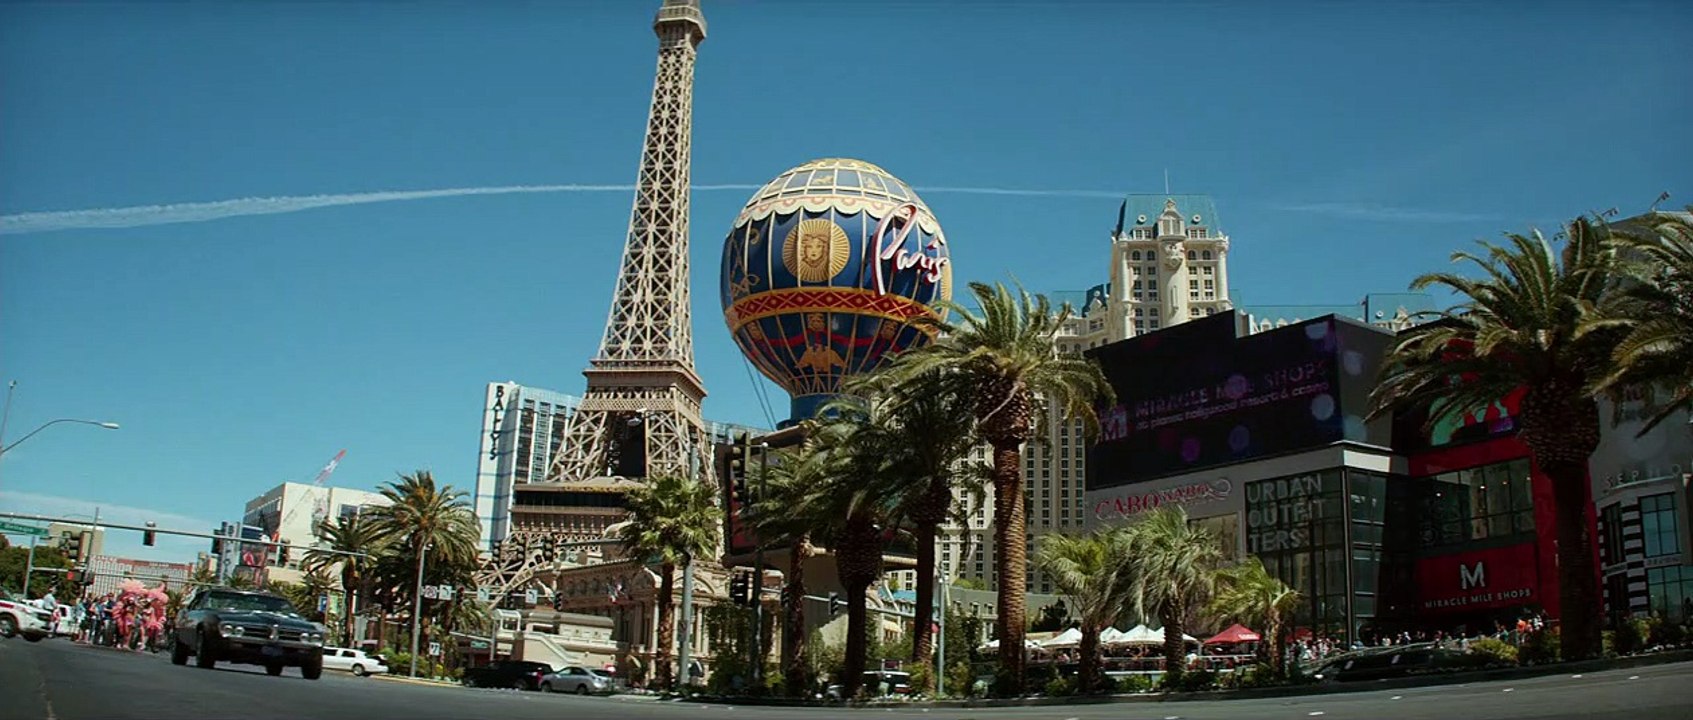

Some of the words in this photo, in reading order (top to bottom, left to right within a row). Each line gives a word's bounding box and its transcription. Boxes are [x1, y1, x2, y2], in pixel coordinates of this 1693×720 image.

[873, 202, 950, 296] Paris
[1246, 473, 1323, 503] URBAN
[1095, 493, 1161, 518] CABO
[1248, 529, 1308, 553] TERS
[1459, 561, 1486, 590] M
[1424, 597, 1467, 608] MIRACLE
[1471, 593, 1493, 603] MILE
[1497, 588, 1532, 601] SHOPS
